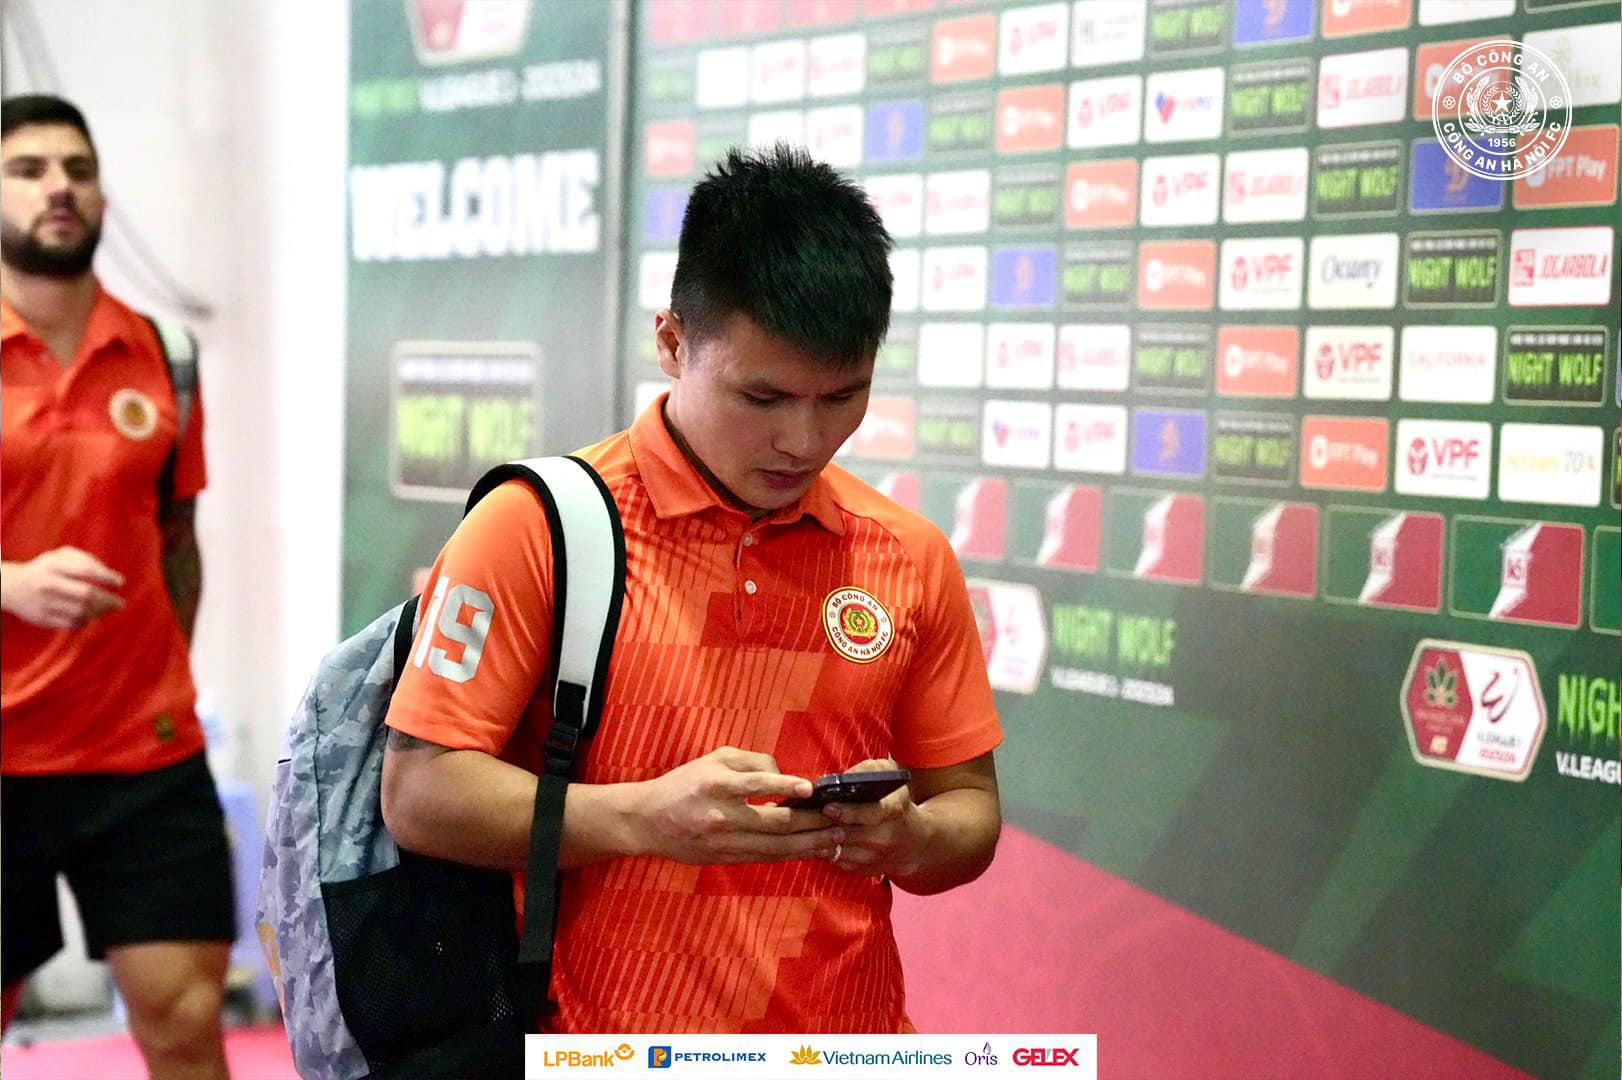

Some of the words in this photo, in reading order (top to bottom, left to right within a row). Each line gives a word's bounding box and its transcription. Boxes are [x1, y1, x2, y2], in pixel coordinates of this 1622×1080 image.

[1576, 154, 1606, 182] Play
[350, 149, 600, 262] WELCOME
[1252, 253, 1293, 283] VPF
[1408, 256, 1452, 289] NIGHT
[1454, 255, 1498, 288] WOLF
[1340, 341, 1383, 372] VPF
[1508, 352, 1554, 387] NIGHT
[1558, 352, 1603, 386] WOLF
[1431, 438, 1480, 468] VPF
[867, 600, 878, 611] AN
[412, 575, 496, 684] 19
[1053, 606, 1112, 657] NIGHT
[1117, 614, 1176, 667] WOLF
[848, 646, 859, 655] AN
